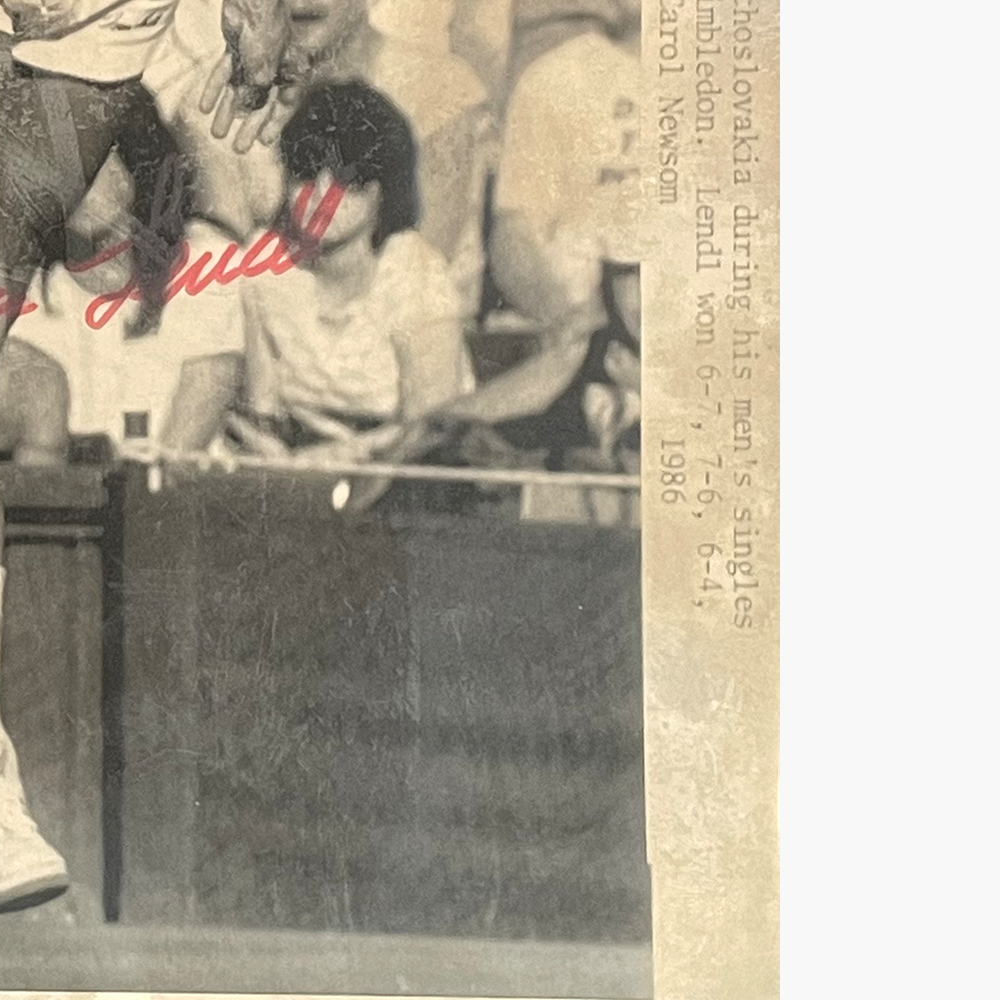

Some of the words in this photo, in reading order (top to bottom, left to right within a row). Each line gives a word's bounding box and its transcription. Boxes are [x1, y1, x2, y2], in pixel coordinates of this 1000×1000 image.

[659, 96, 684, 204] Newsom
[696, 189, 721, 272] Lendl
[726, 204, 759, 310] during
[696, 293, 717, 345] won
[733, 330, 759, 379] his
[733, 399, 758, 487] men's
[692, 455, 722, 518] 7-6,
[692, 542, 722, 608] 6-4,
[727, 507, 759, 629] singles
